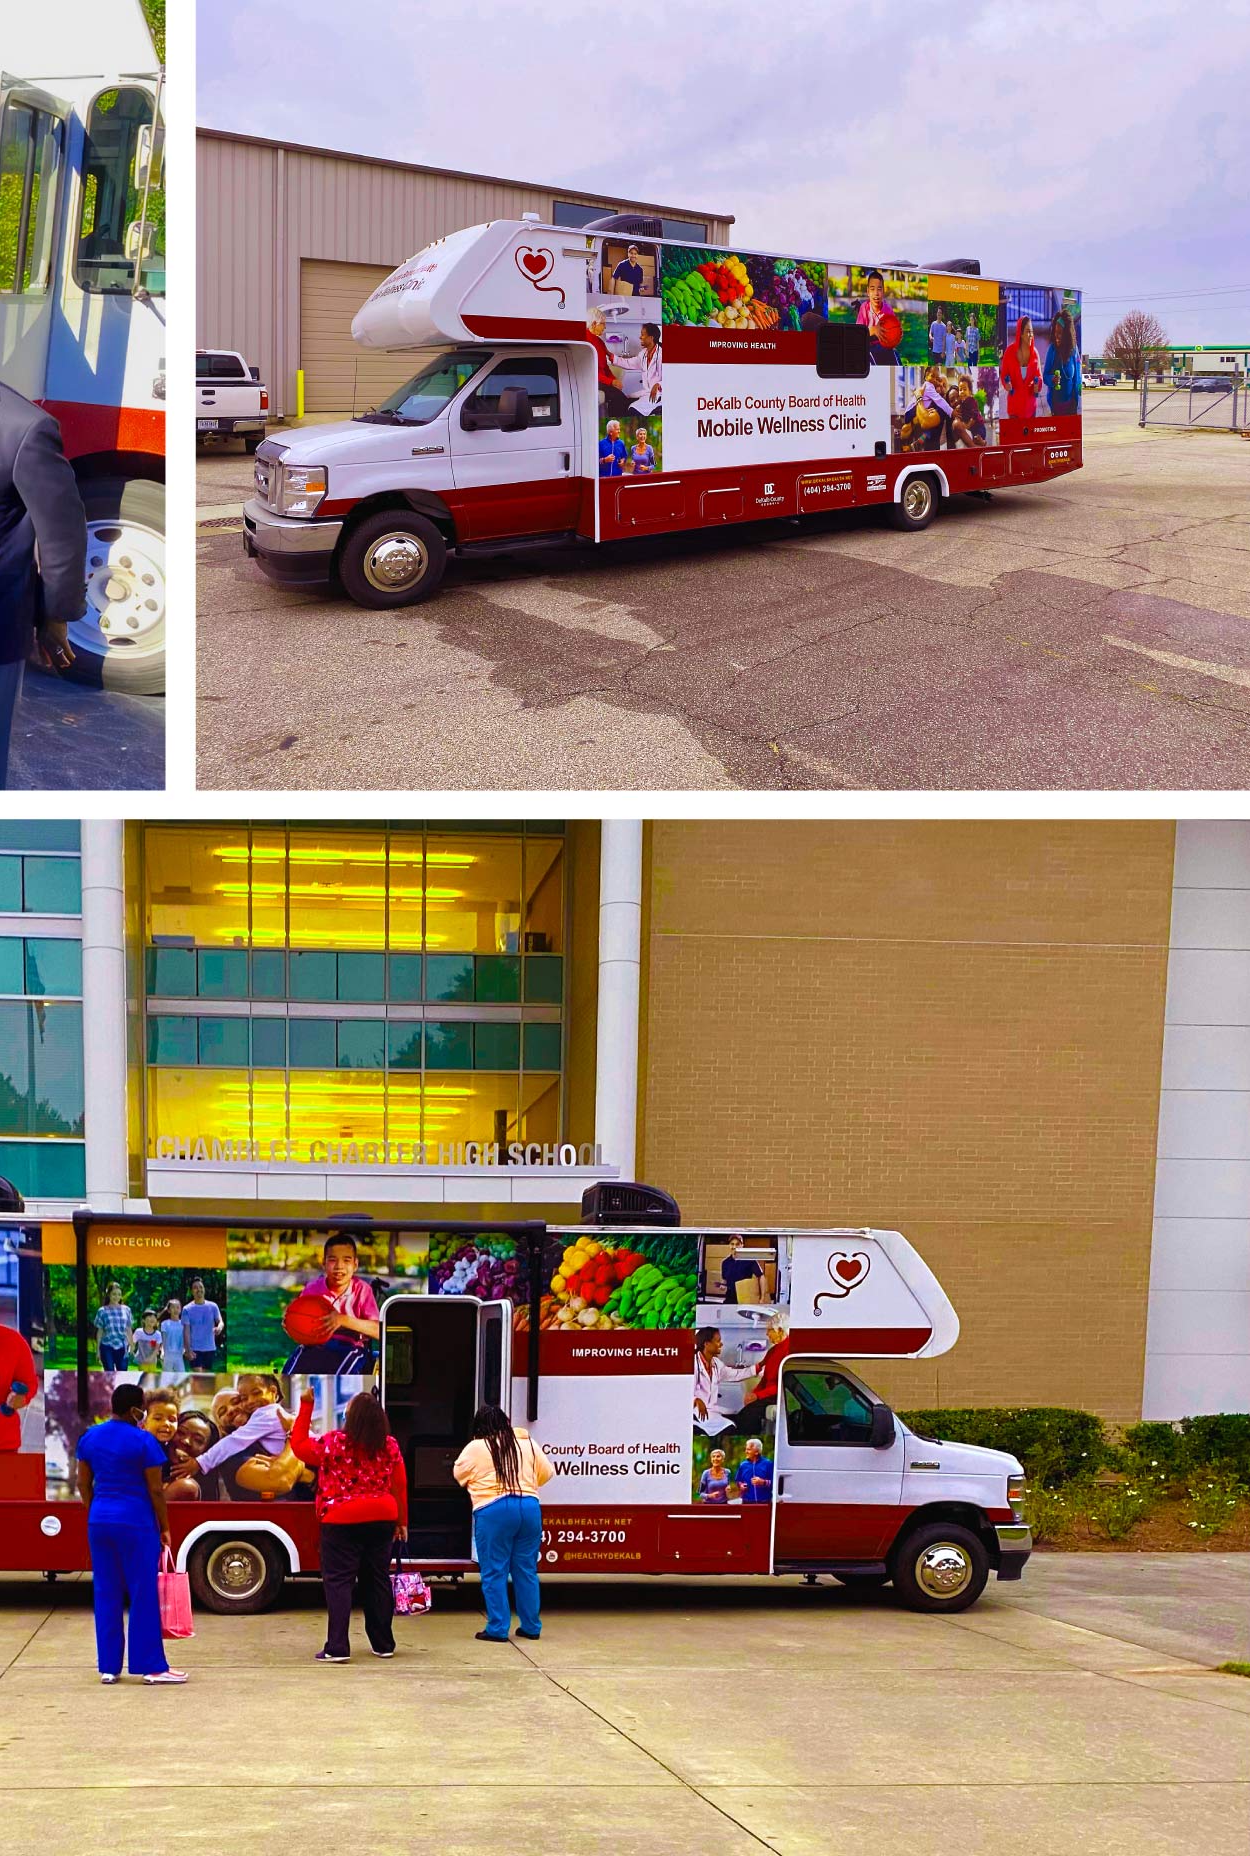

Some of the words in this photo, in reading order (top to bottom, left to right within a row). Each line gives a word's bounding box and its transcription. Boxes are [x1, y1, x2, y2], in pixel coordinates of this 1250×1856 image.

[709, 341, 748, 349] IMPROVING
[750, 342, 776, 350] HEALTH
[697, 397, 742, 411] DeKalb
[745, 397, 785, 411] County
[788, 395, 820, 408] Board
[823, 395, 833, 407] of
[835, 394, 866, 407] Health
[697, 418, 753, 438] Mobile
[757, 416, 825, 434] Wellness
[828, 414, 867, 430] Clinic
[804, 485, 820, 496] (404)
[822, 483, 851, 493] 294-3700
[156, 1135, 298, 1162] CHAMBLEE
[309, 1140, 427, 1165] CHARTER
[438, 1142, 500, 1166] HIGH
[508, 1142, 610, 1167] SCHOOL
[97, 1237, 171, 1247] PROTECTING
[572, 1348, 632, 1357] IMPROVING
[636, 1347, 678, 1356] HEALTH
[542, 1444, 585, 1457] County
[588, 1444, 625, 1455] Board
[627, 1443, 640, 1454] of
[642, 1443, 681, 1454] Health
[553, 1461, 629, 1476] Wellness
[634, 1460, 681, 1475] Clinic
[557, 1530, 626, 1543] 294-3700
[563, 1552, 641, 1560] @HEALTHYDEKALB
